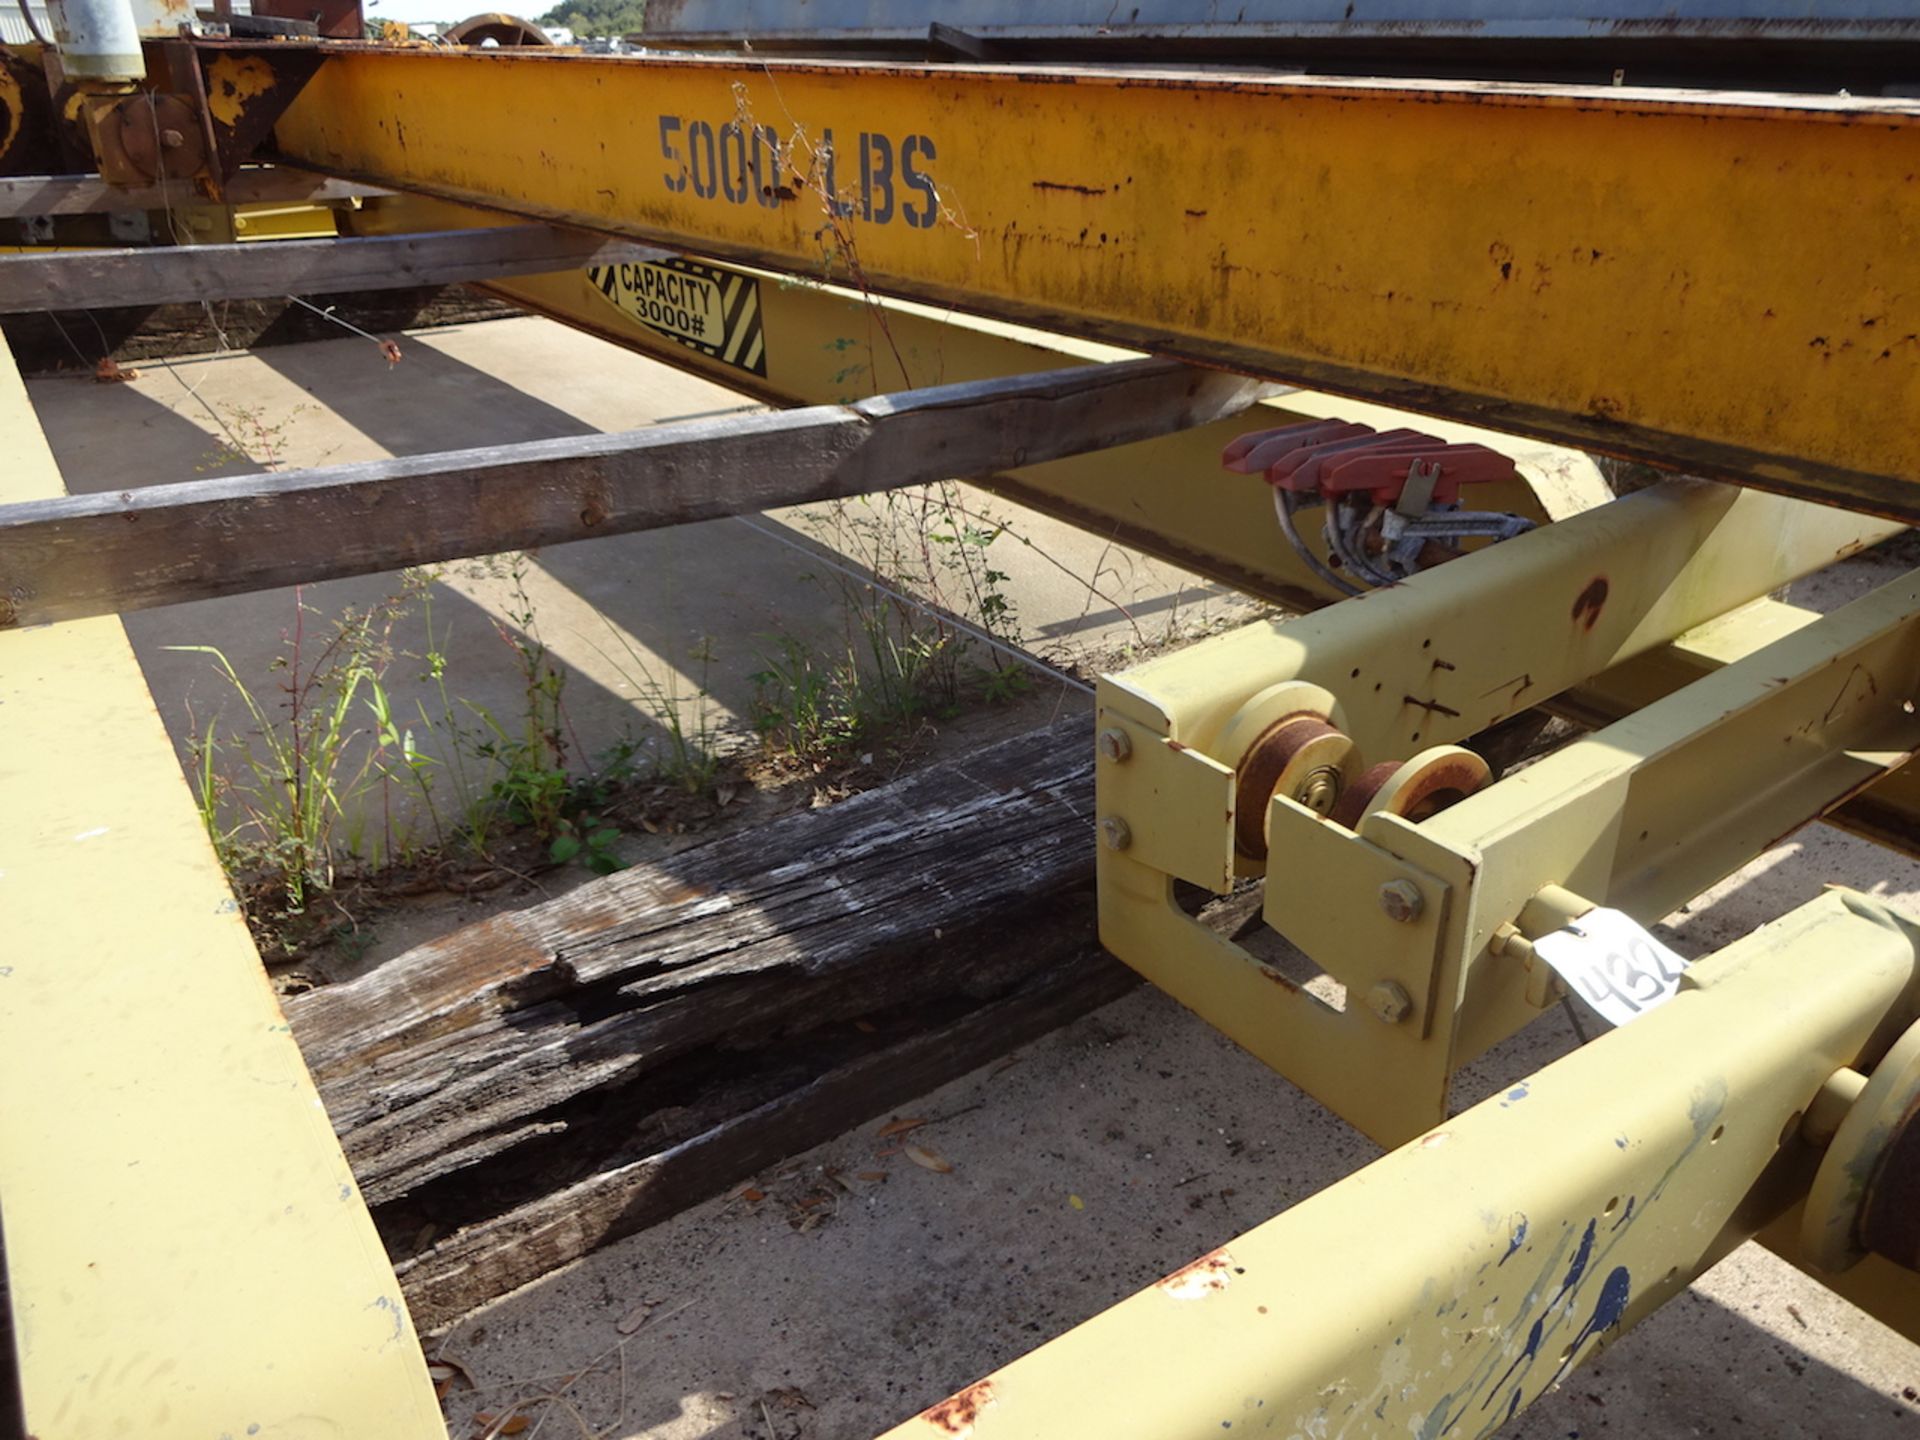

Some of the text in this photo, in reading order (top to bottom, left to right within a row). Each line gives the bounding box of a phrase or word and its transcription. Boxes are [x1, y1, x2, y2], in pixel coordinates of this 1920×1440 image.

[659, 115, 937, 229] 5000 LBS
[620, 263, 711, 315] CAPACITY
[635, 296, 706, 337] 3000#
[1579, 937, 1682, 1013] 432
